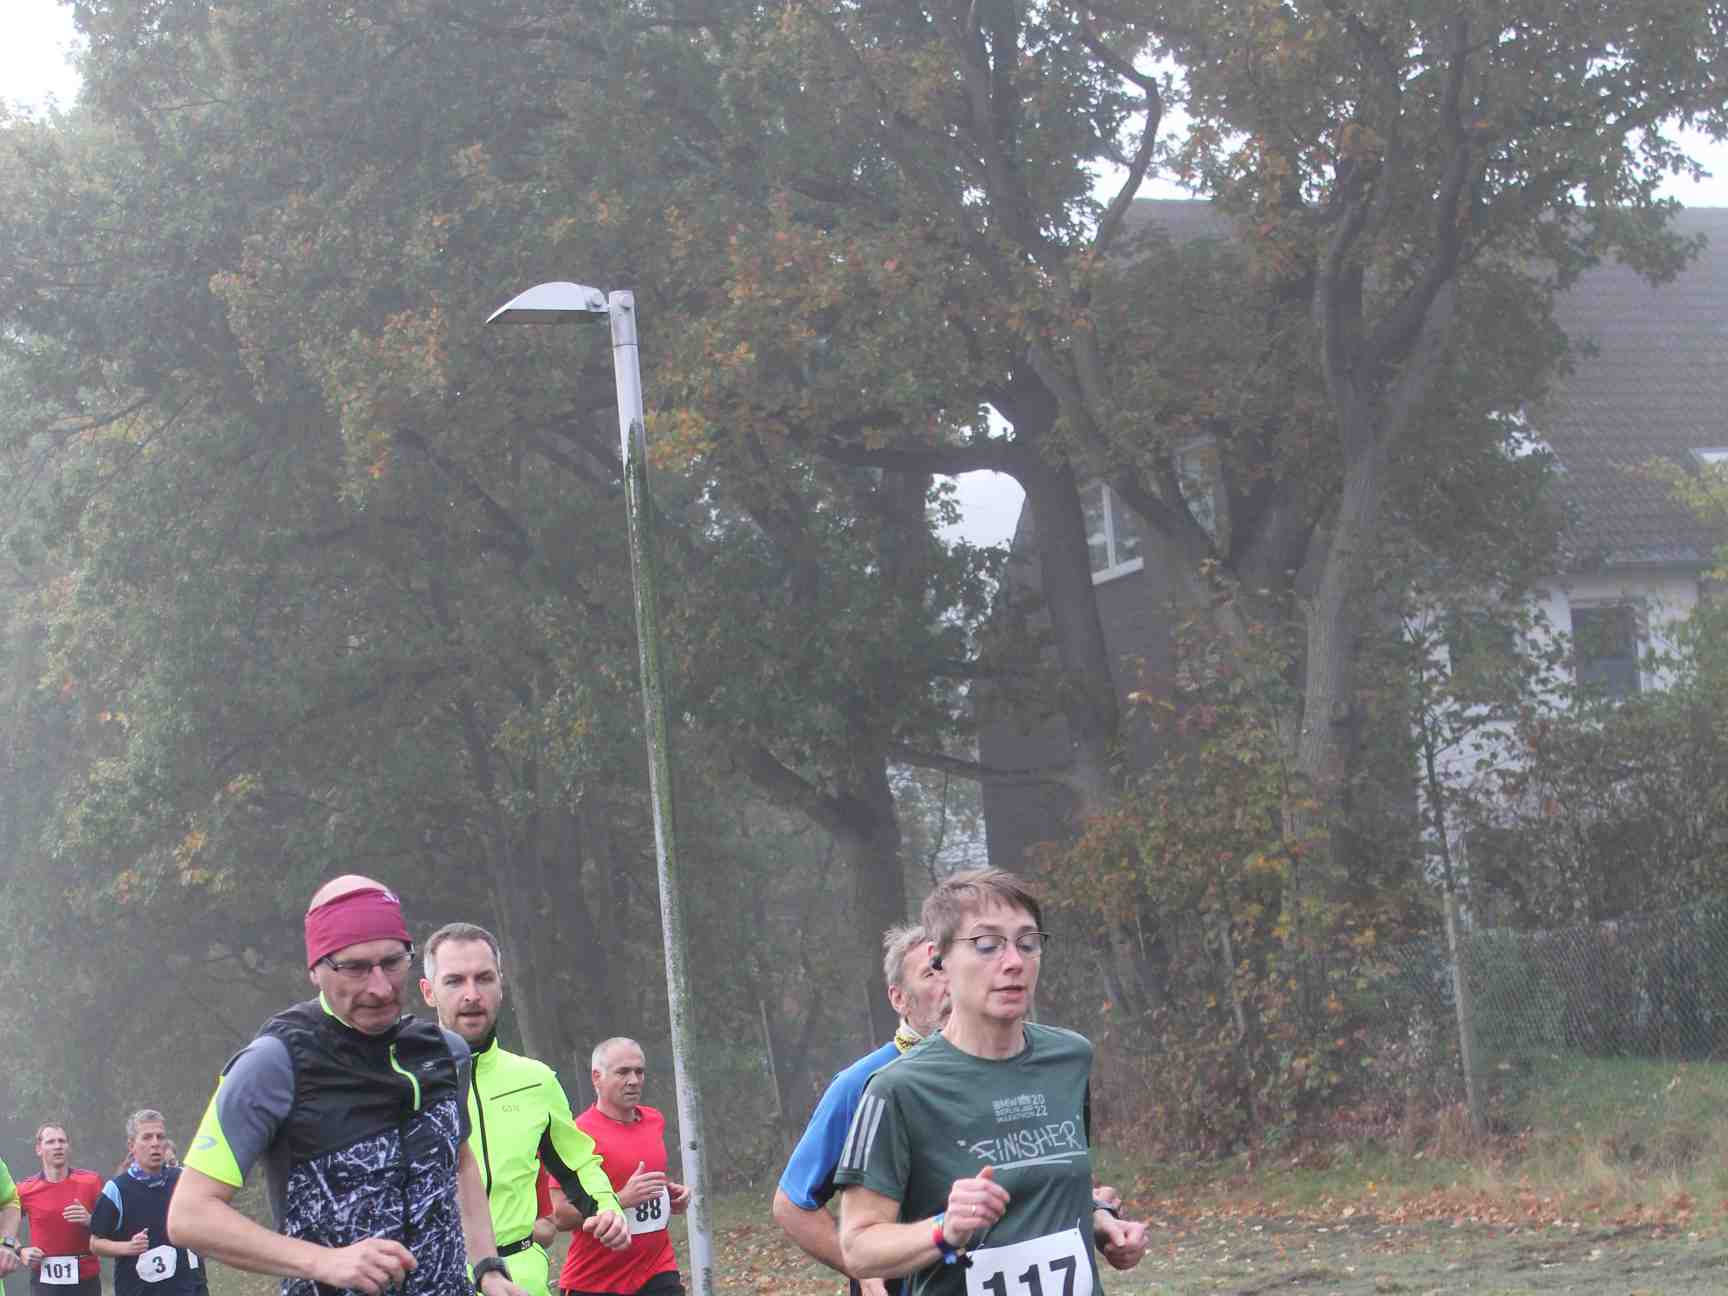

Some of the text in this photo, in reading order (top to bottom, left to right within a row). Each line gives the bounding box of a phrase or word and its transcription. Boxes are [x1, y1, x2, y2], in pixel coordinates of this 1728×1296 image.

[1033, 1104, 1048, 1117] 22
[635, 1197, 662, 1222] 88
[44, 1263, 71, 1278] 101
[152, 1256, 166, 1274] 3
